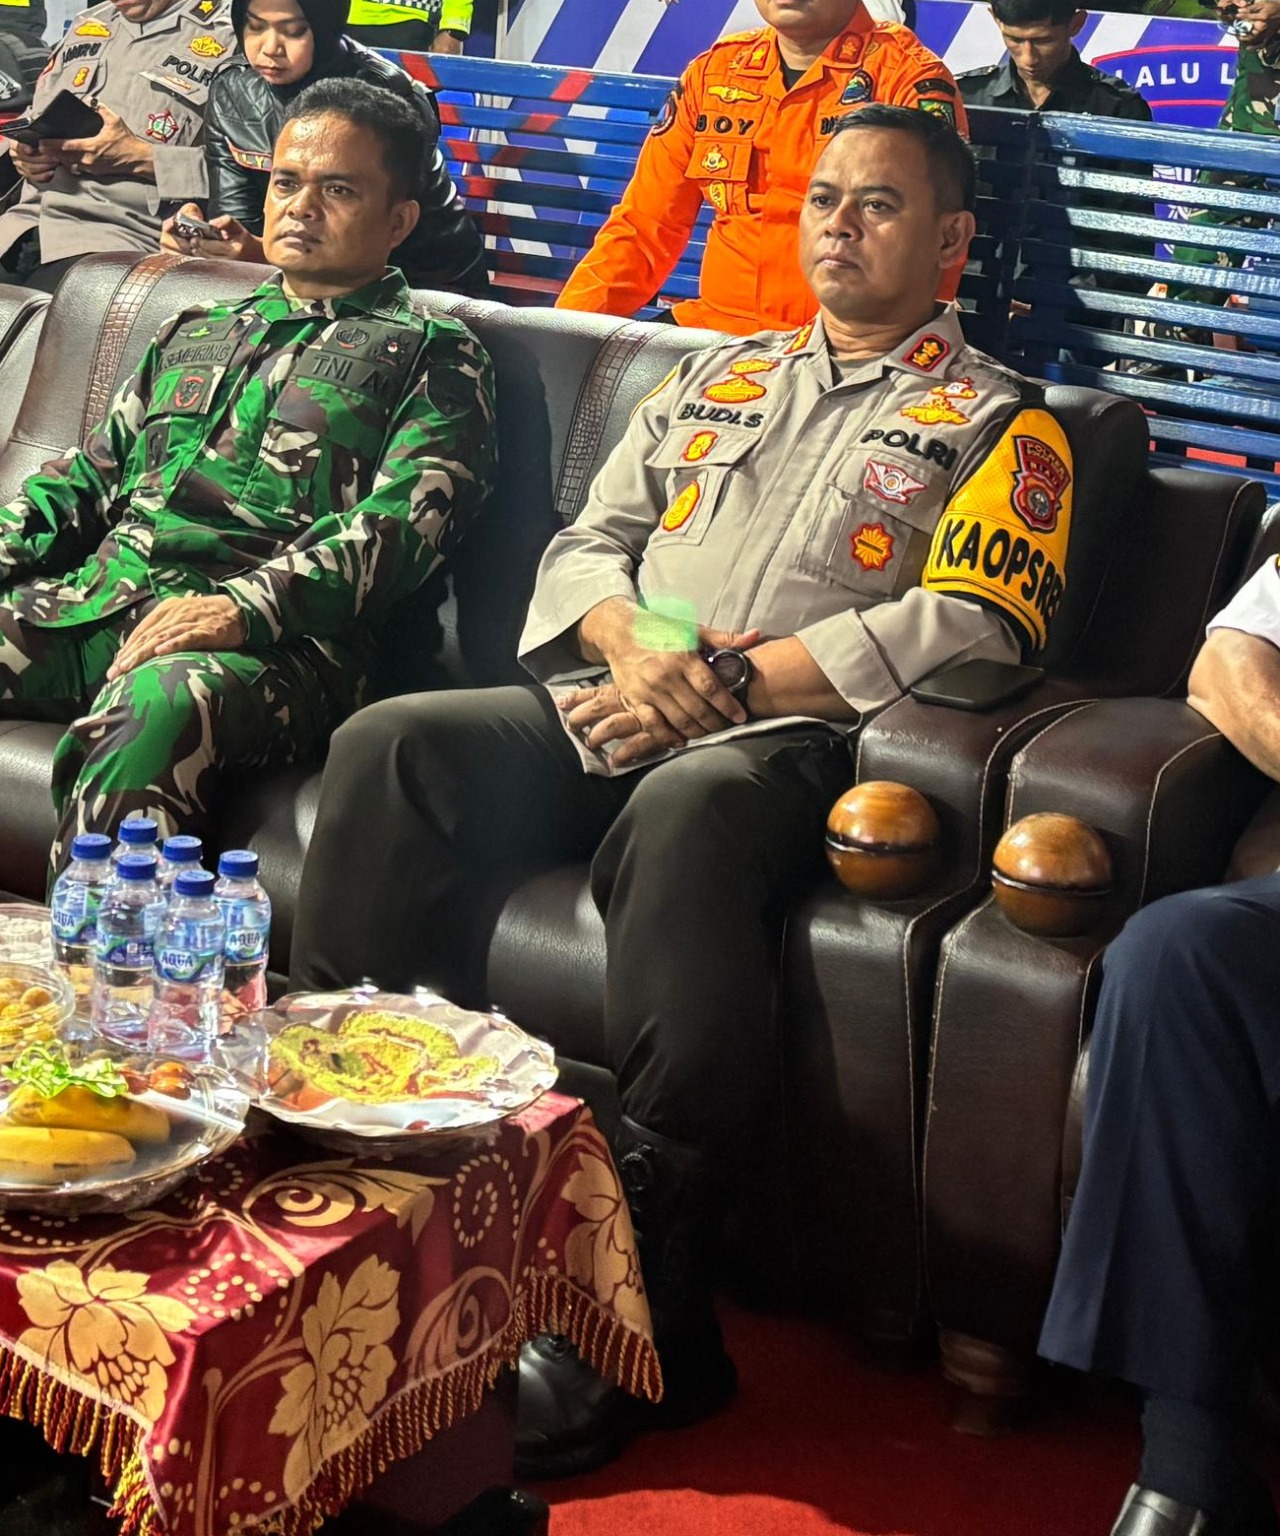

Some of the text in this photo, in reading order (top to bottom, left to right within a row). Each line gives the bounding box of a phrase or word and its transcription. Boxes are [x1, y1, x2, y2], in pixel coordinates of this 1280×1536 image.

[696, 115, 754, 135] BOY
[314, 356, 353, 382] TNI
[860, 429, 958, 471] POLRI
[230, 930, 261, 946] AQUA
[160, 950, 193, 968] AQUA
